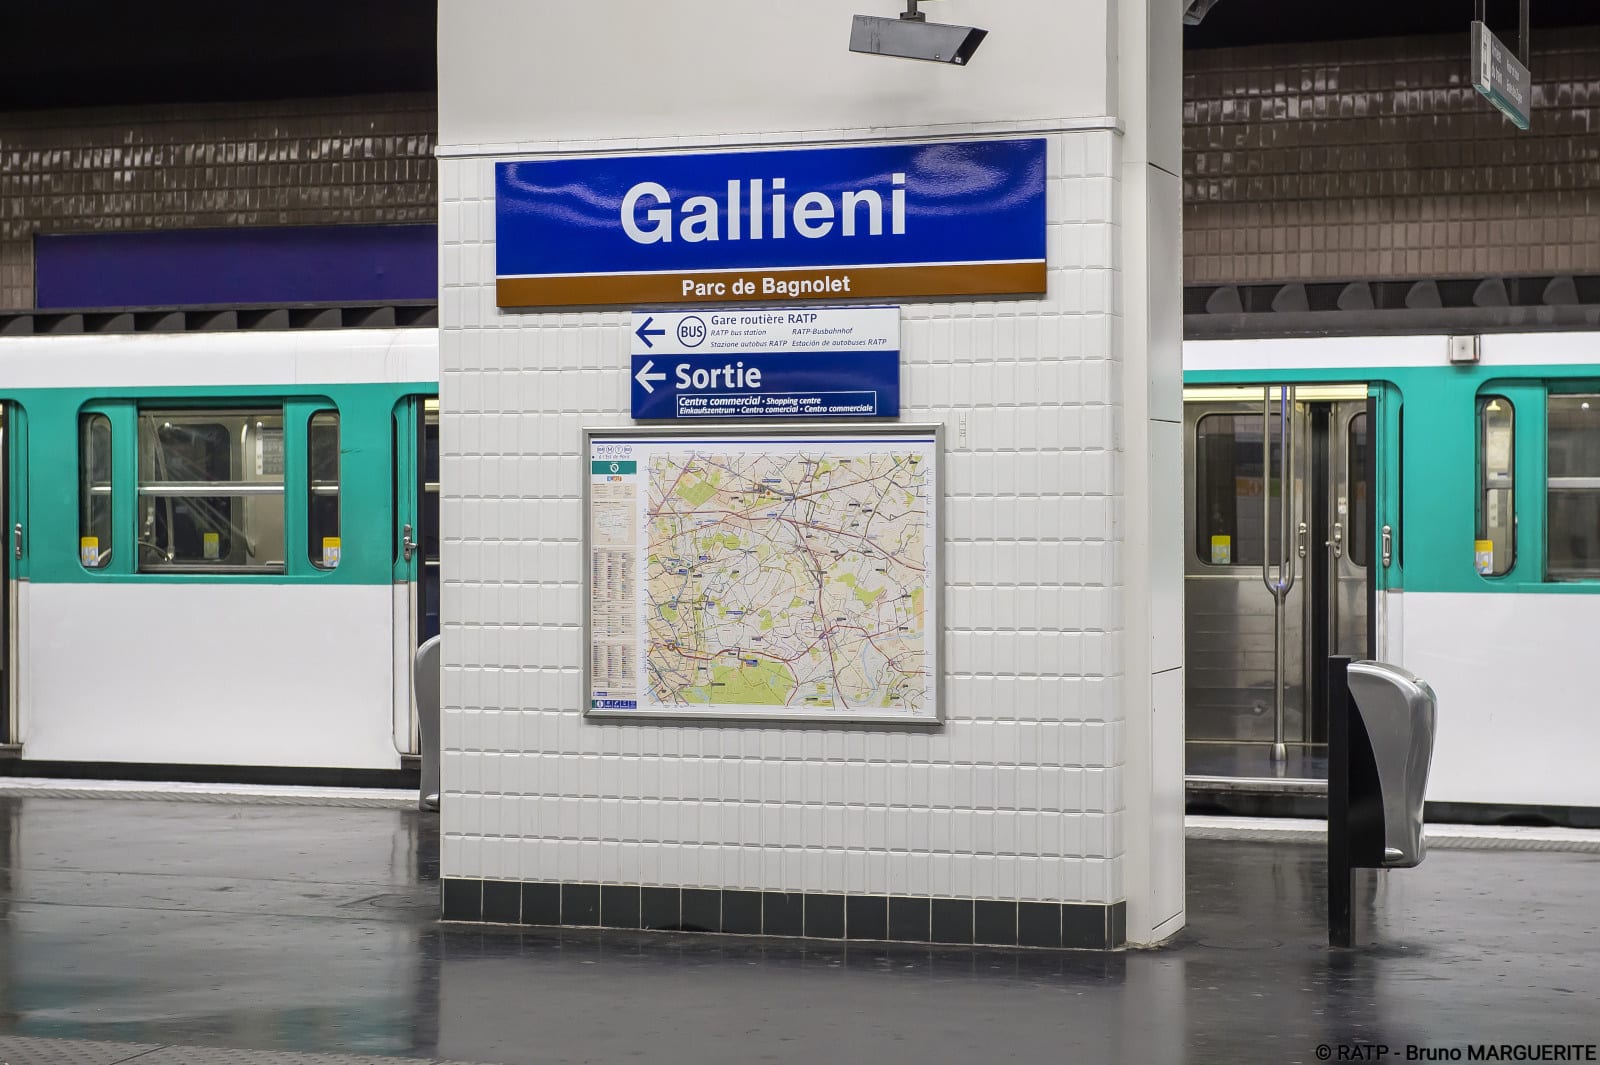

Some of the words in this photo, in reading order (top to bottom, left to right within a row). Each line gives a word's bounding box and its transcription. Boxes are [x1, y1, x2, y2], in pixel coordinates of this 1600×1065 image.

[620, 173, 906, 245] Gallieni
[682, 279, 726, 296] Parc
[732, 278, 756, 295] de
[761, 275, 851, 296] Bagnolet
[711, 315, 737, 325] Gare
[740, 314, 784, 324] routière
[788, 313, 818, 324] RATP
[681, 325, 703, 338] BUS
[710, 329, 729, 337] RATP
[740, 340, 767, 348] autobus
[791, 339, 820, 347] Estación
[675, 361, 761, 389] Sortie
[679, 397, 708, 406] Centre
[709, 395, 761, 406] commercial
[766, 397, 798, 405] Shopping
[799, 397, 822, 405] centre
[679, 406, 736, 415] Einkaufszentrum
[741, 406, 764, 414] Centro
[804, 405, 827, 413] Centro
[829, 404, 873, 412] commerciale
